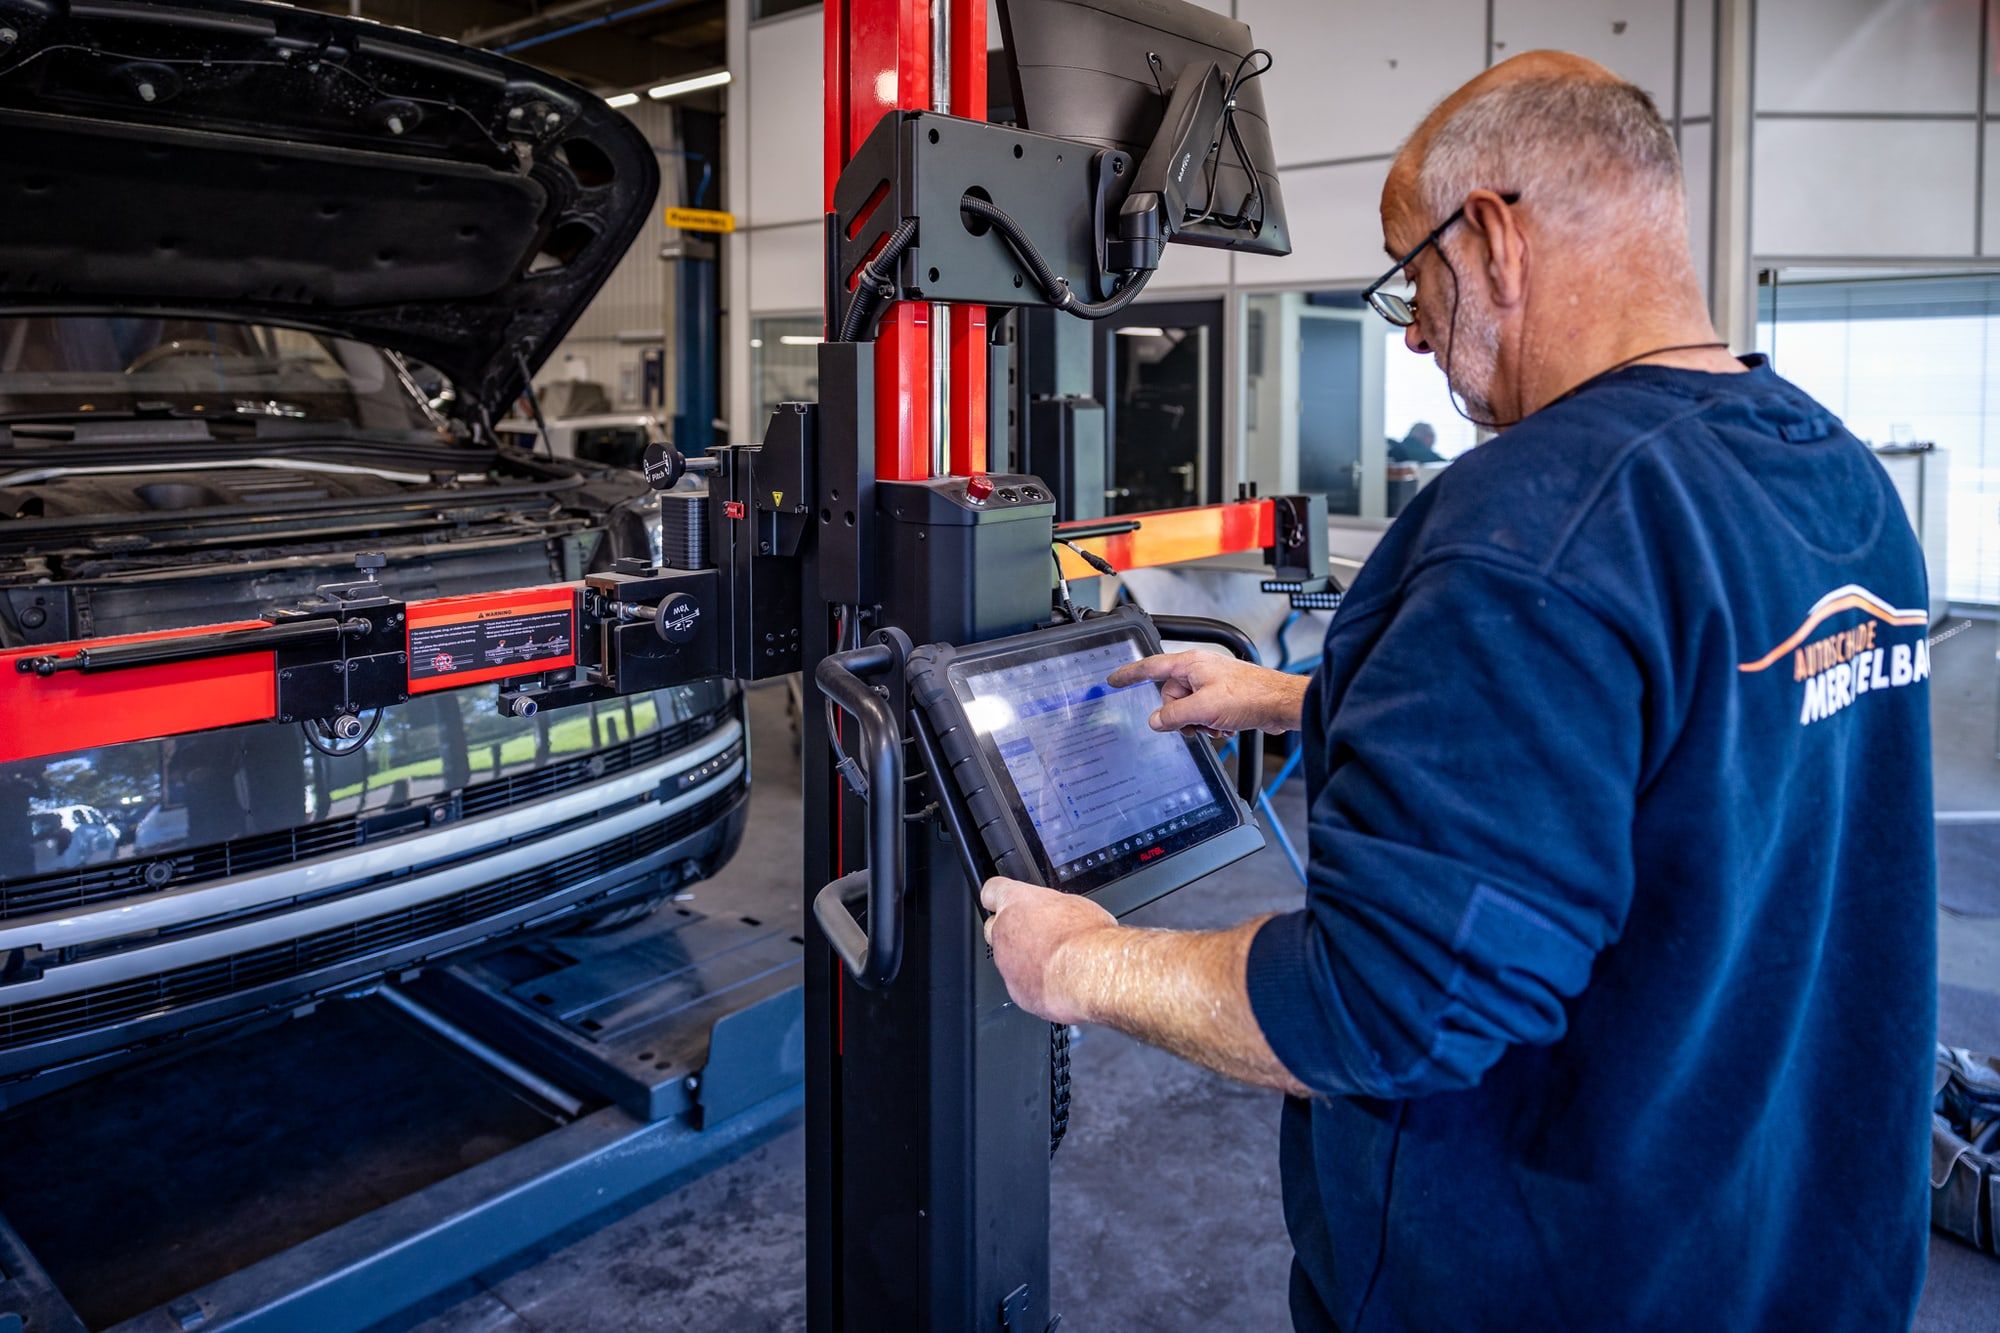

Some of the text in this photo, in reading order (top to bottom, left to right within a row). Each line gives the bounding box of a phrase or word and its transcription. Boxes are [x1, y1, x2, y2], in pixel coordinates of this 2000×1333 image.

[652, 470, 665, 482] Pitch
[673, 603, 690, 615] Yaw
[1794, 619, 1877, 682] AUTOSCHDE
[1140, 847, 1165, 862] AUTEL
